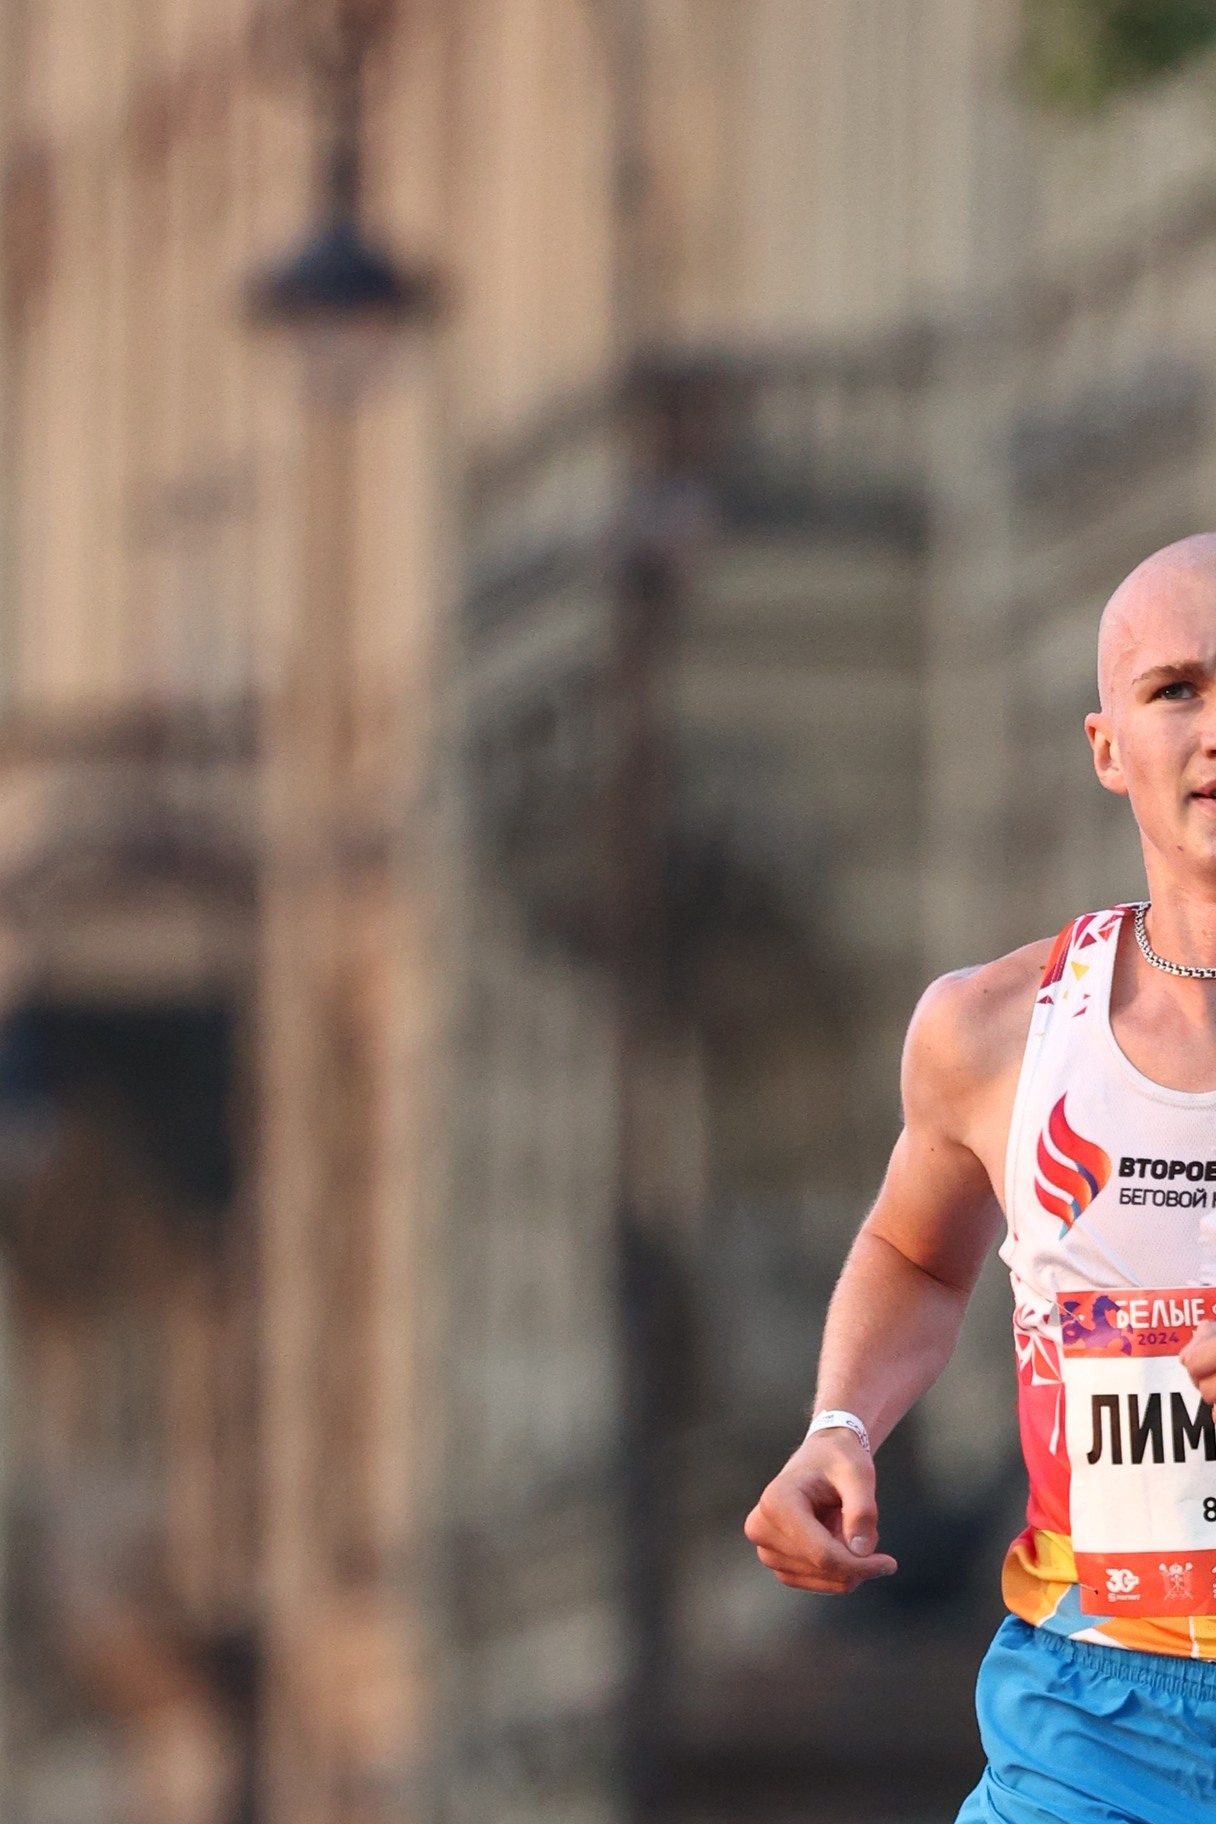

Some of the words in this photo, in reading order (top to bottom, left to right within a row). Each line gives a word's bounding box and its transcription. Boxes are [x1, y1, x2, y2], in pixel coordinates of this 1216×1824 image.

[1119, 1187, 1208, 1208] БЕГОВОЙ
[1116, 1298, 1205, 1330] БЕЛЫЕ
[1137, 1332, 1180, 1346] 2024
